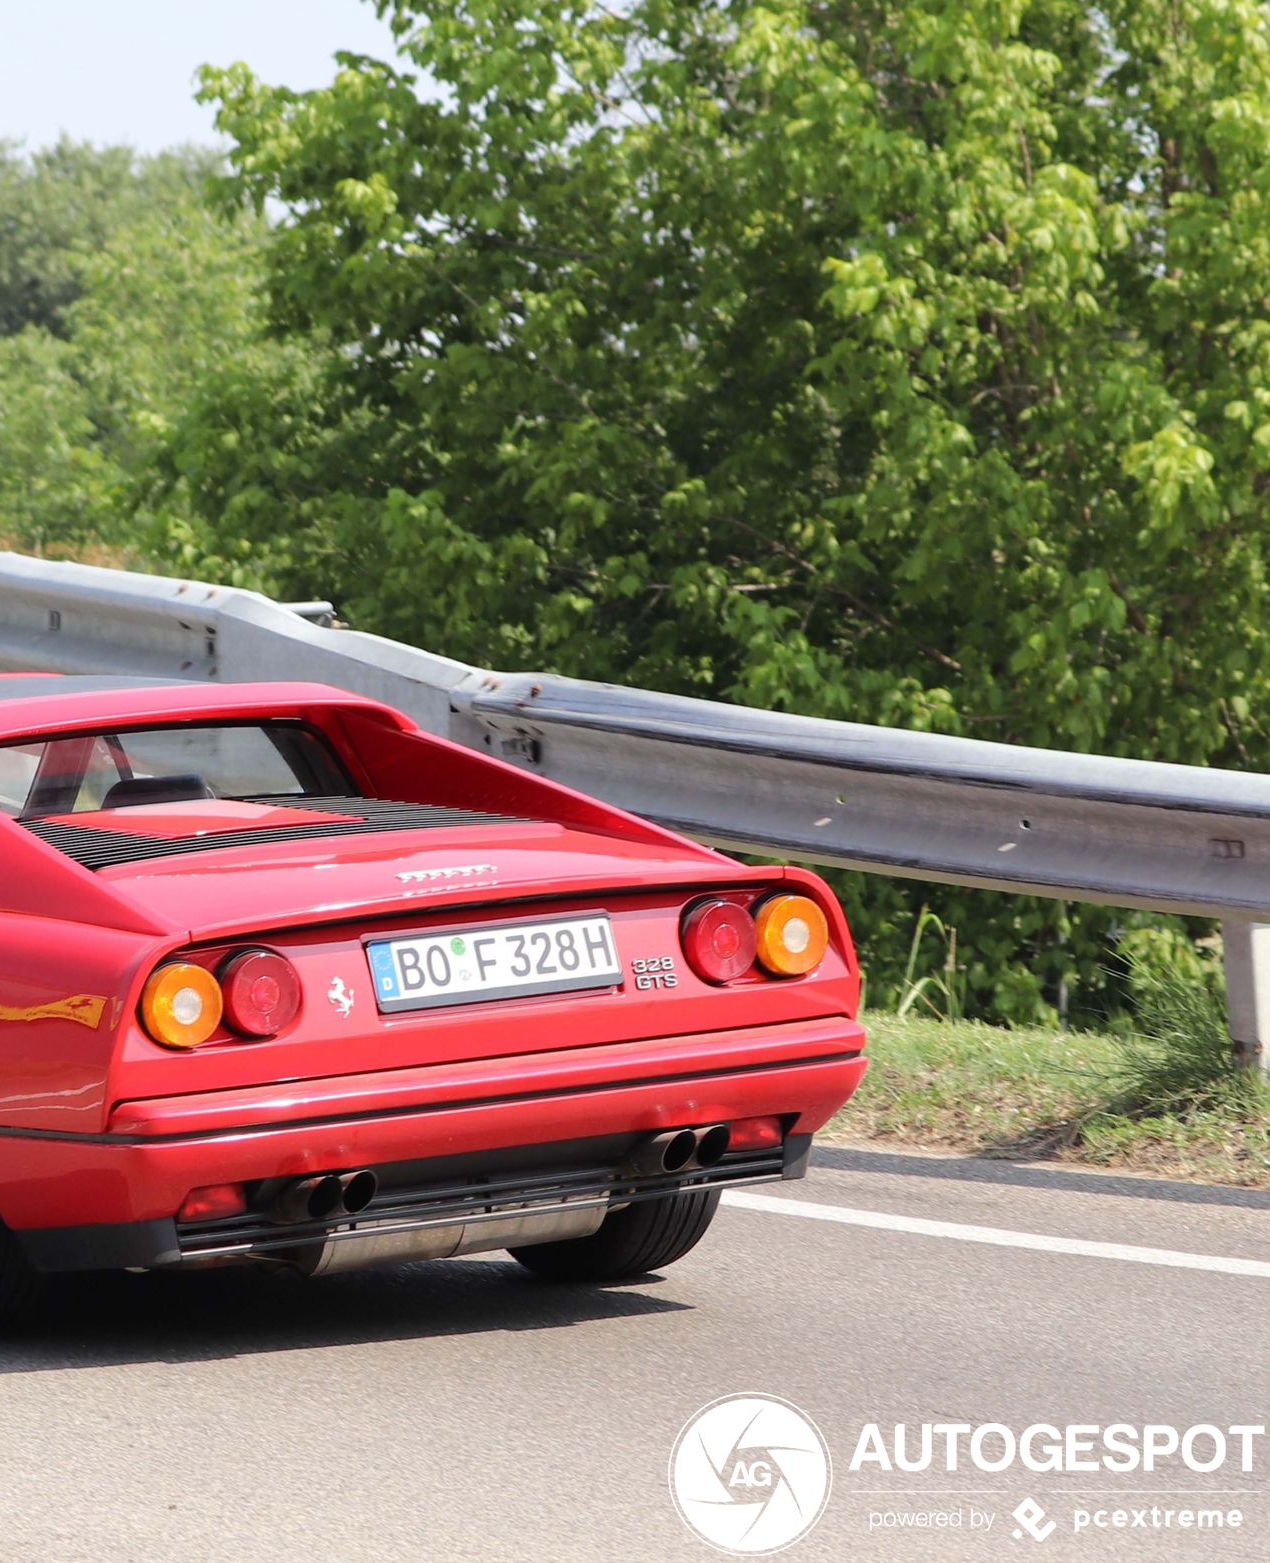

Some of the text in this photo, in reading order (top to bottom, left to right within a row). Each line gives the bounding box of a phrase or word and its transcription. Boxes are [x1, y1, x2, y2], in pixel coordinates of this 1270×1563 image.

[396, 944, 452, 991] BO
[473, 938, 497, 982] F
[632, 956, 675, 974] 328
[635, 973, 679, 990] GTS
